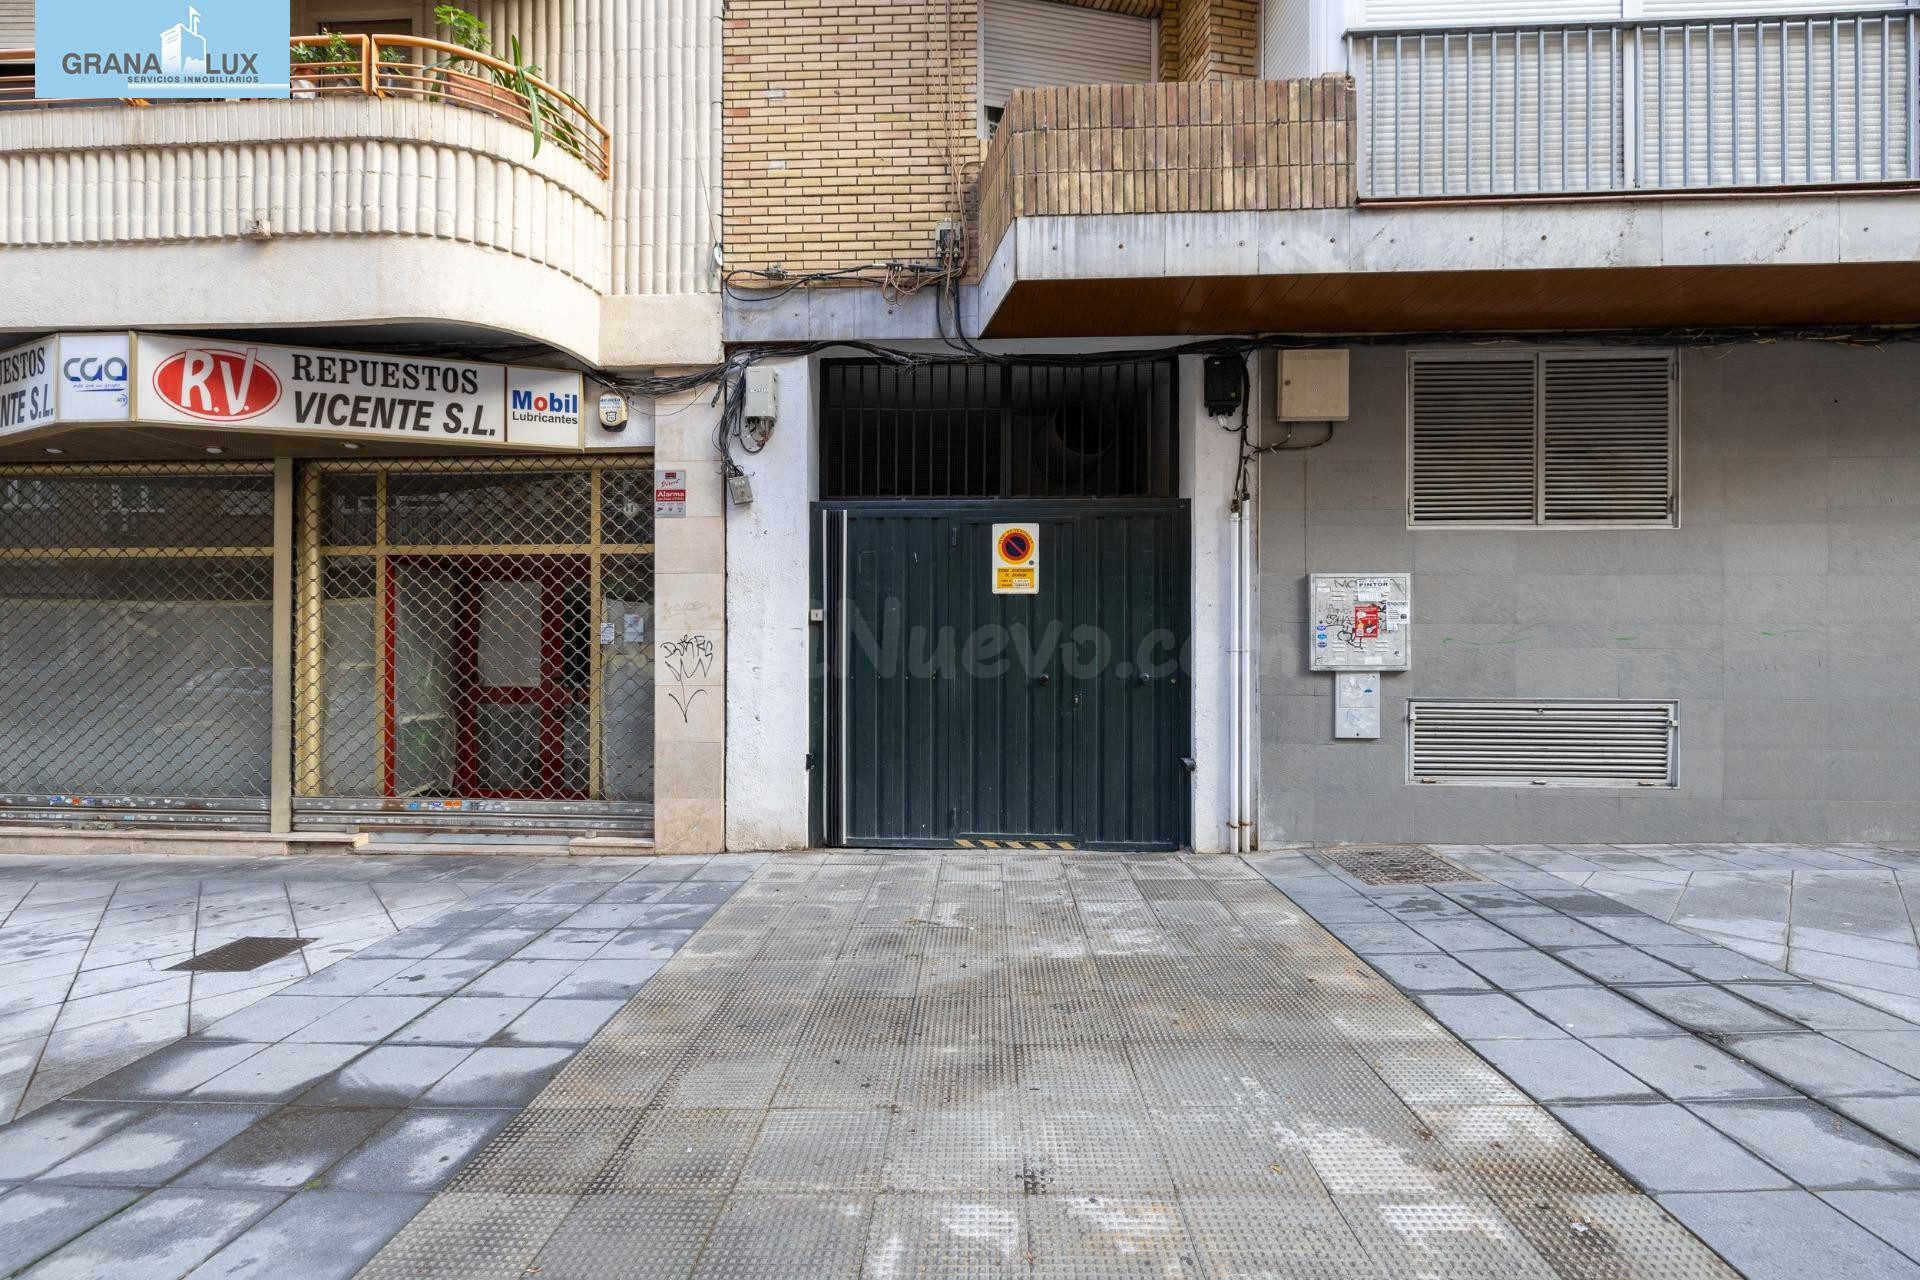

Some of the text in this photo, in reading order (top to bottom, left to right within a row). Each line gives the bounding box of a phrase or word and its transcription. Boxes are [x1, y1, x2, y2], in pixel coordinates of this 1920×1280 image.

[0, 346, 45, 385] ESTOS
[291, 354, 478, 395] REPUESTOS
[30, 383, 53, 420] S.L.
[294, 391, 496, 437] VICENTE S.L.
[511, 390, 578, 414] Mobil
[512, 412, 578, 425] Lubricantes
